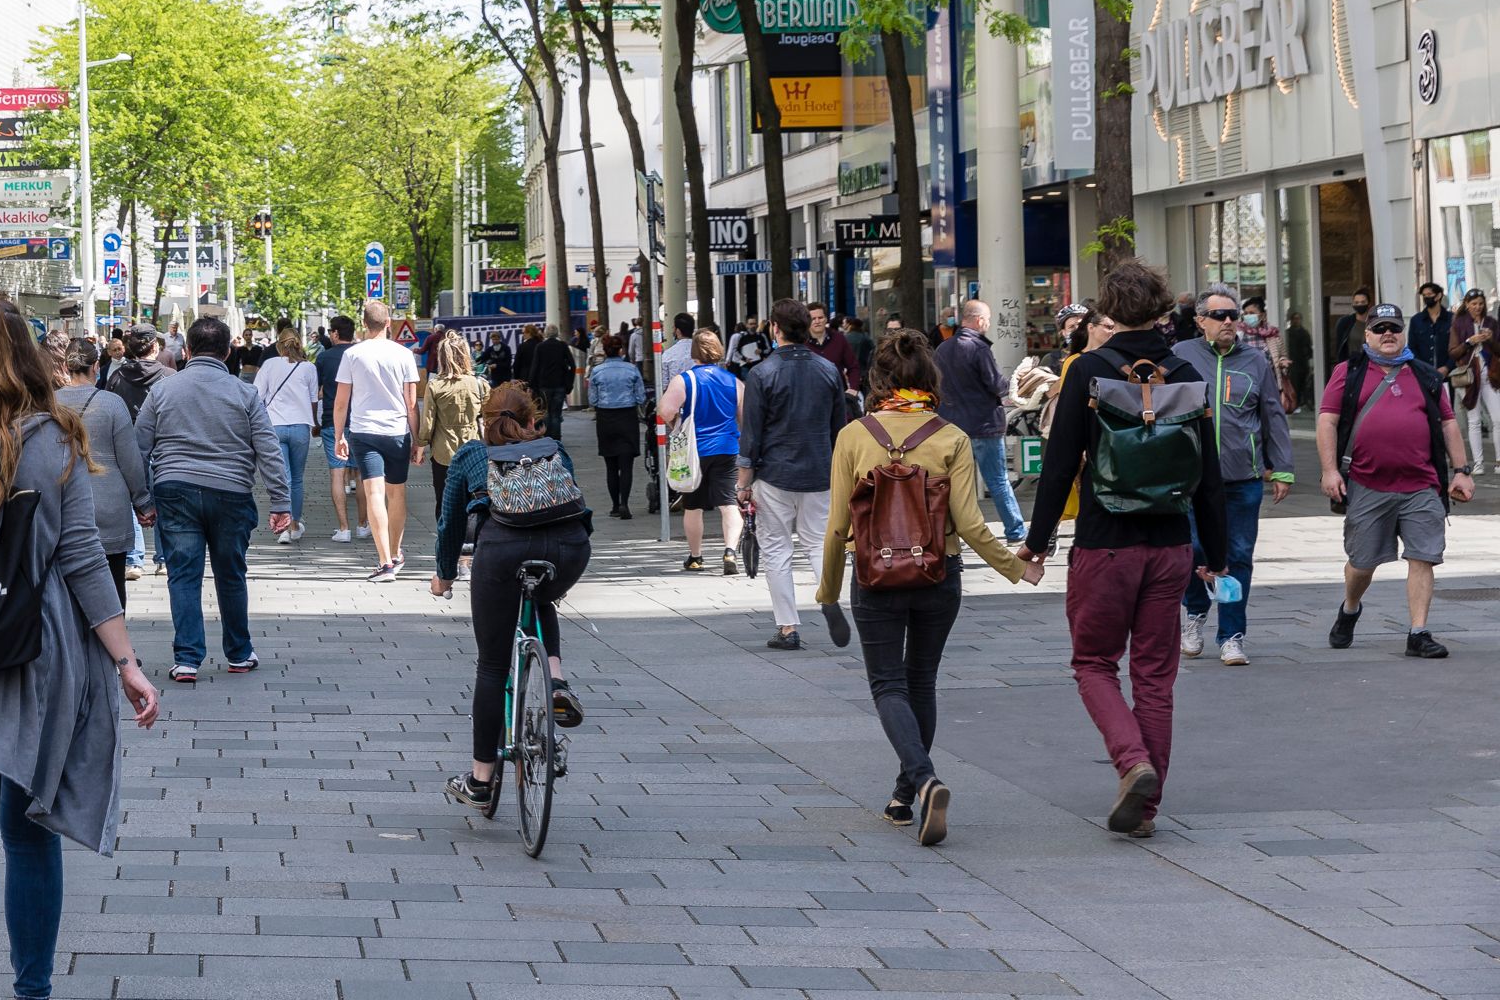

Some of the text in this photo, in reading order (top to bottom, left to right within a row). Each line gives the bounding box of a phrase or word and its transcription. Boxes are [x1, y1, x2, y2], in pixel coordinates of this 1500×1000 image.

[1067, 17, 1092, 142] PULL&BEAR
[3, 181, 53, 191] MERKUR
[709, 220, 748, 245] INO
[719, 262, 749, 274] HOTEL
